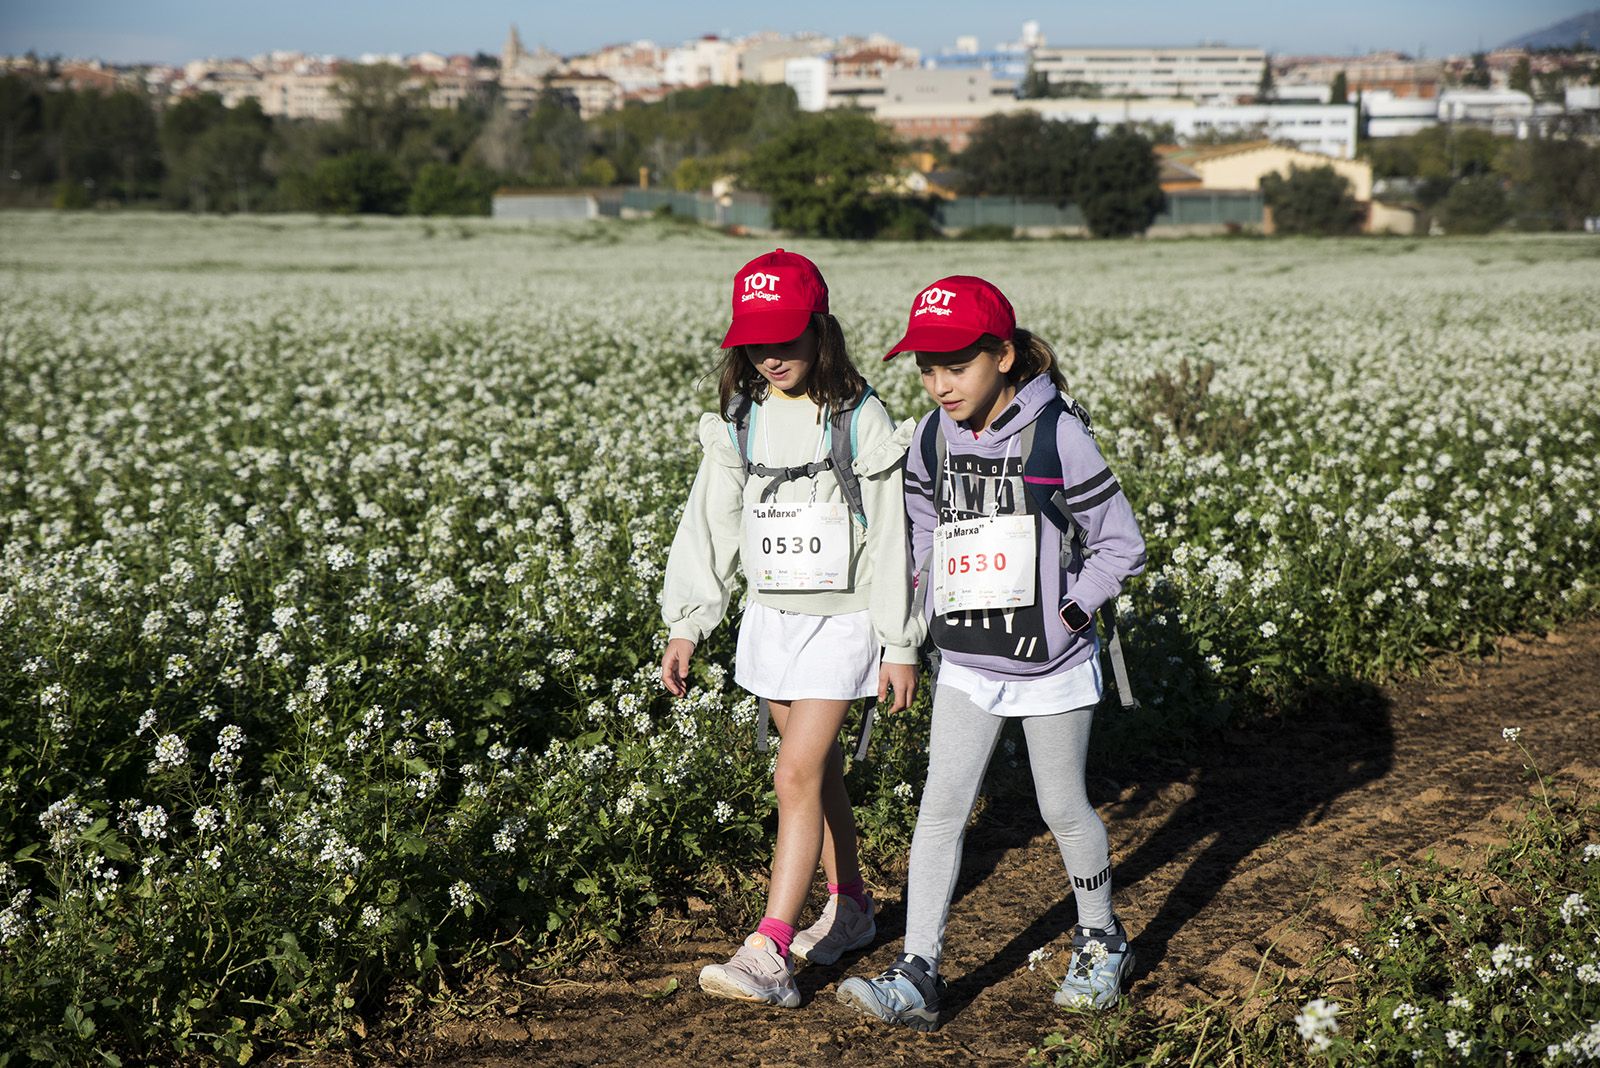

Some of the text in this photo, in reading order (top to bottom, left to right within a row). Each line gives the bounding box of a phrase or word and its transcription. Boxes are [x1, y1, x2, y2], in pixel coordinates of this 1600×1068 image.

[744, 272, 780, 292] TOT
[920, 287, 957, 307] TOT
[762, 536, 821, 555] 0530
[947, 552, 1007, 576] 0530
